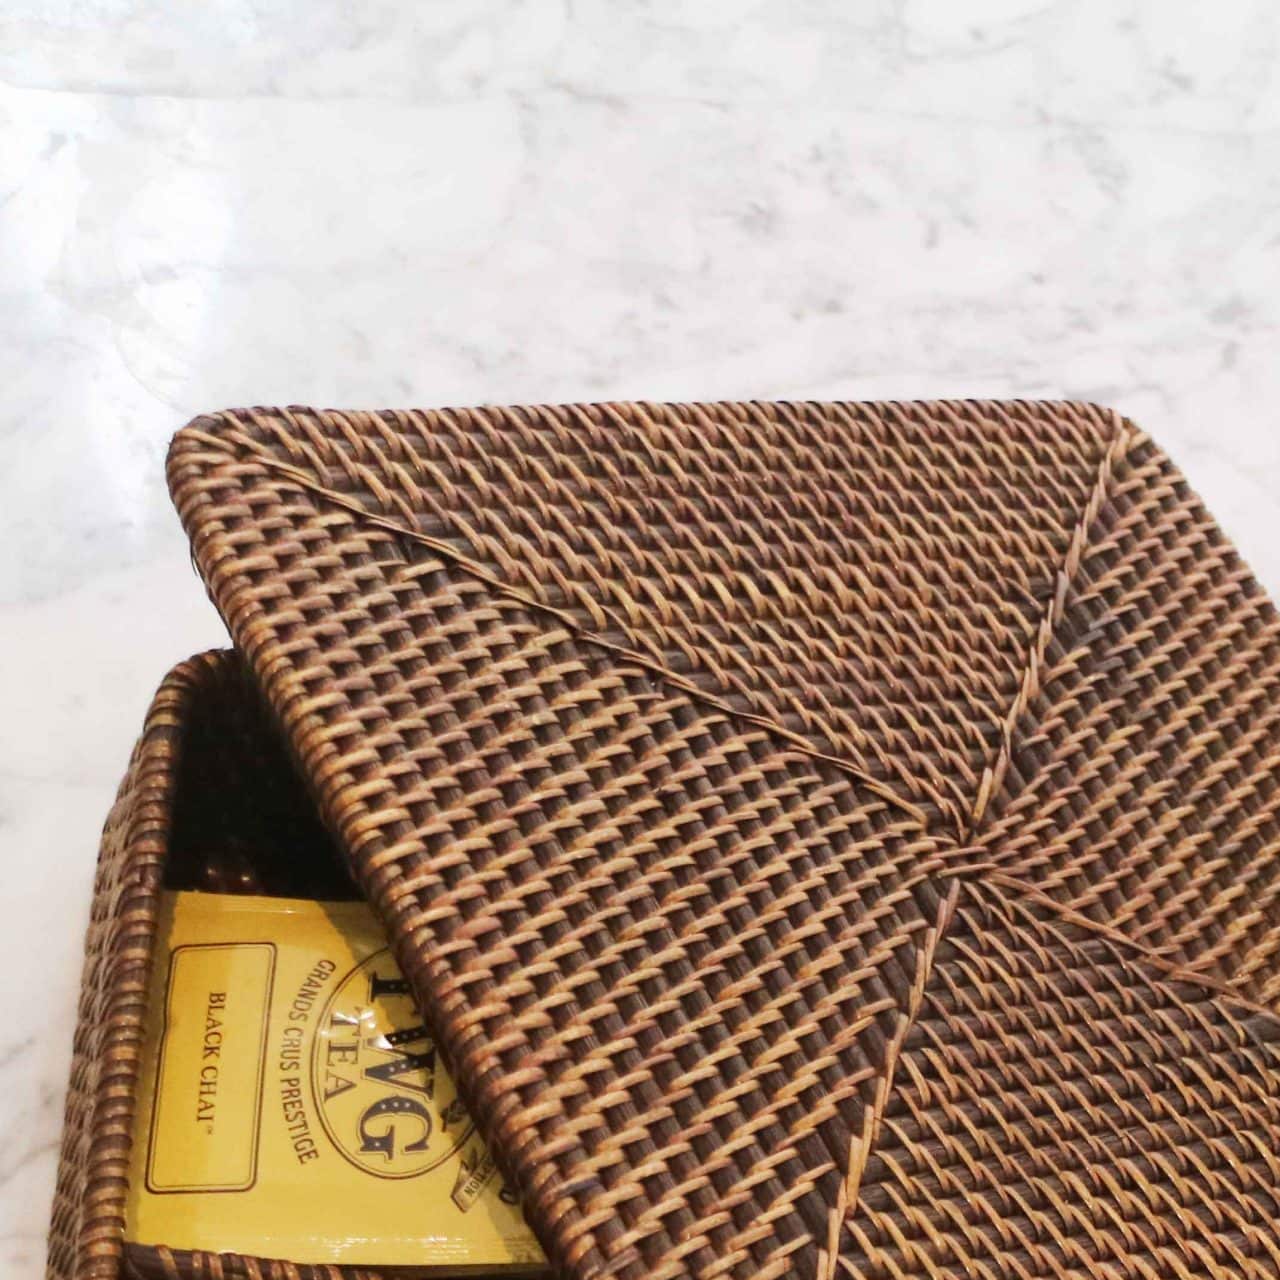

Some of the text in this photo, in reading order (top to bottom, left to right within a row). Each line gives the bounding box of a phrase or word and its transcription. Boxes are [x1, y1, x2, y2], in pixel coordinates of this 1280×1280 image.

[197, 992, 227, 1122] BLACK CHAI
[280, 959, 337, 1166] GRANDS CRUS PRESTIGE
[323, 1006, 364, 1103] TEA
